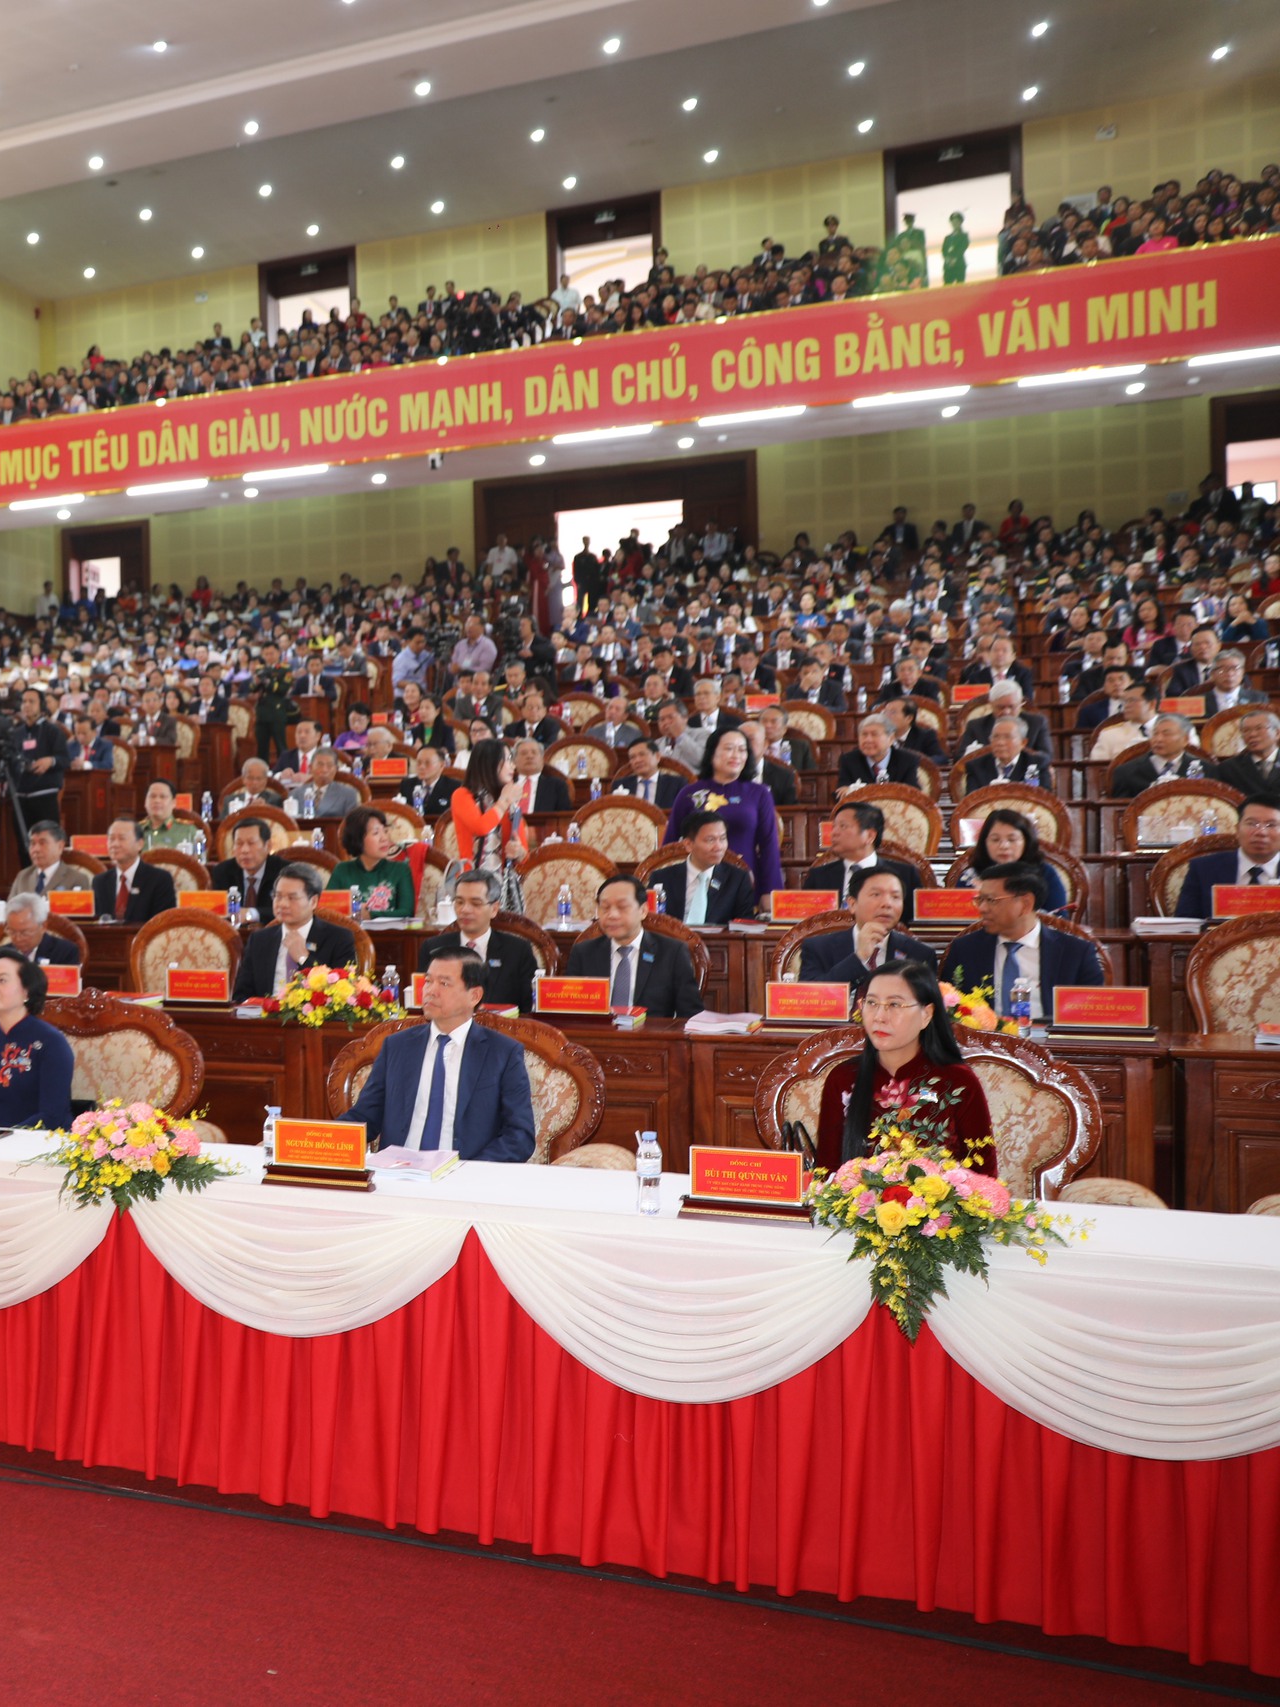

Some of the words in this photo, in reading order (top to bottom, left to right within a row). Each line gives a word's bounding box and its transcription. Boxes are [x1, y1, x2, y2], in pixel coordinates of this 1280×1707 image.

[0, 444, 60, 490] MỤC
[68, 429, 129, 477] TIÊU
[138, 419, 198, 467] DÂN
[208, 408, 290, 458] GIÀU,
[300, 393, 388, 446] NƯỚC
[400, 381, 513, 437] MẠNH,
[525, 363, 599, 417] DÂN
[611, 342, 699, 406] CHỦ,
[711, 337, 820, 393] CÔNG
[834, 312, 965, 378] BẰNG,
[979, 297, 1070, 358] VĂN
[1086, 279, 1218, 345] MINH
[285, 1138, 314, 1148] NGUYỄN
[704, 1168, 720, 1178] BÙI
[721, 1170, 736, 1181] THỊ
[738, 1170, 768, 1181] QUỲNH
[769, 1172, 788, 1183] VÂN
